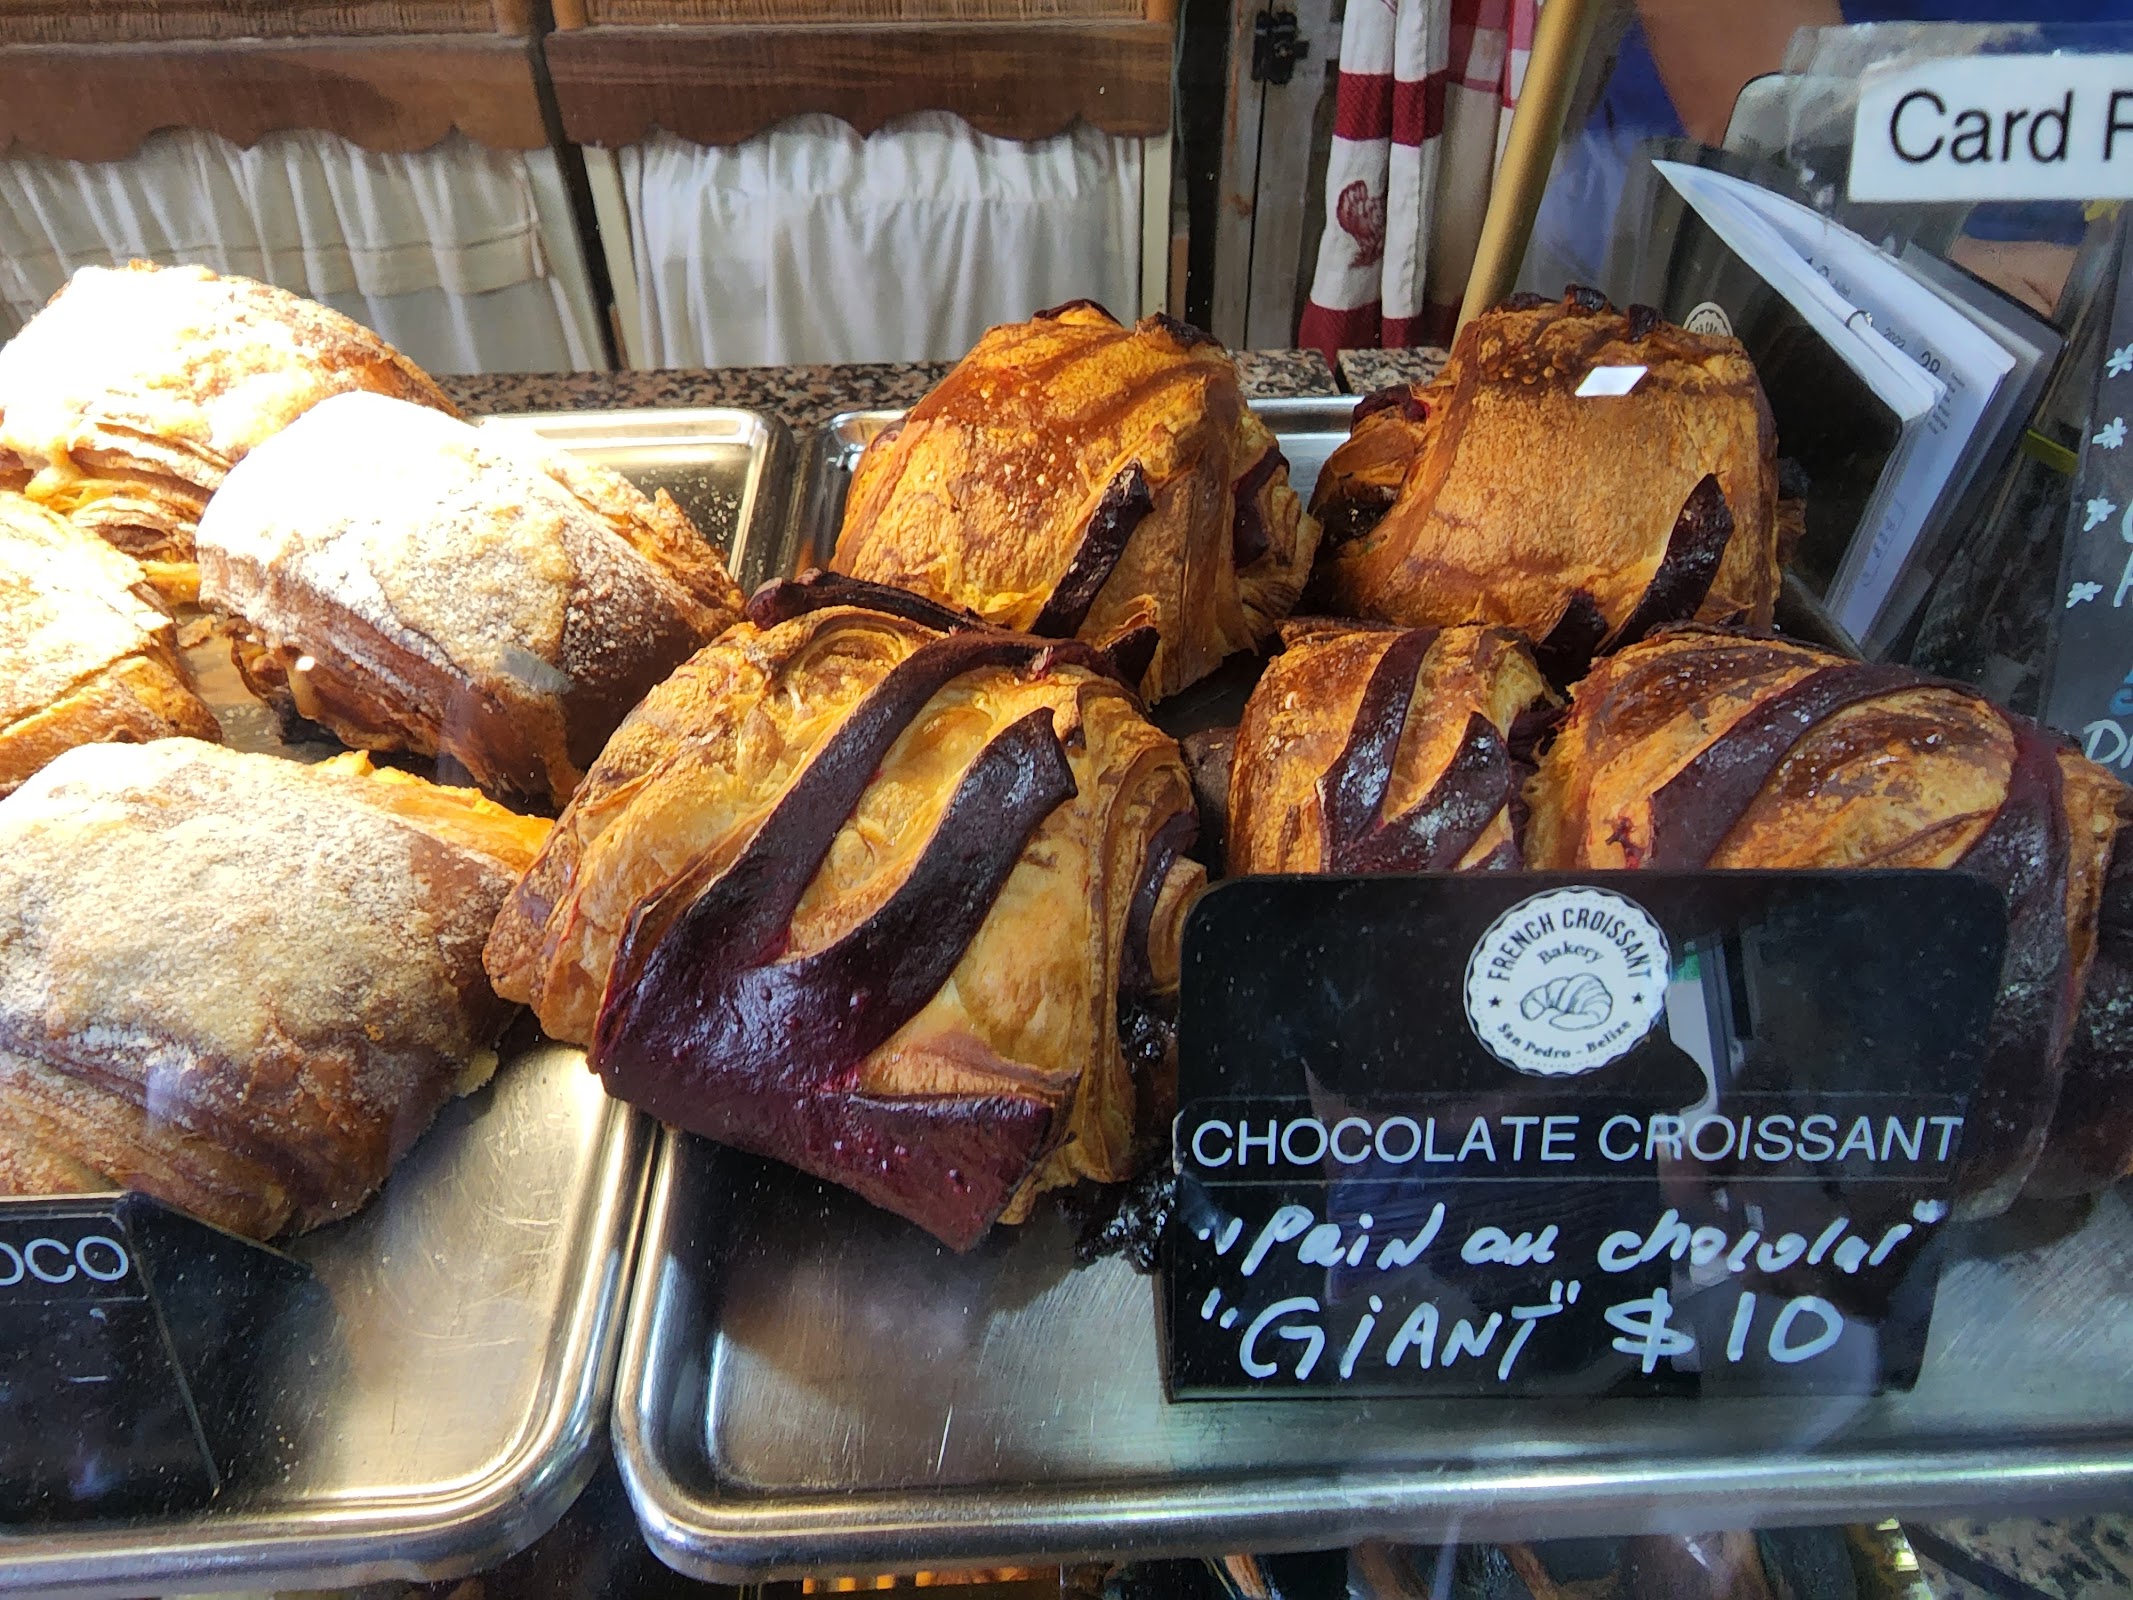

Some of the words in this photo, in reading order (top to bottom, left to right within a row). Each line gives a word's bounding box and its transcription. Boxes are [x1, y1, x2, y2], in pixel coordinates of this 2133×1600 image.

[1889, 87, 2074, 164] Card
[1487, 912, 1555, 983] FRENCH
[1562, 907, 1652, 979] CROISSANT
[1537, 941, 1604, 966] Bakery
[1497, 1021, 1523, 1047] San
[1524, 1040, 1571, 1059] Pedro
[1585, 1019, 1633, 1054] Belize
[1191, 1115, 1581, 1168] CHOCOLATE
[1598, 1113, 1965, 1162] CROISSANT
[1460, 1223, 1560, 1267] au
